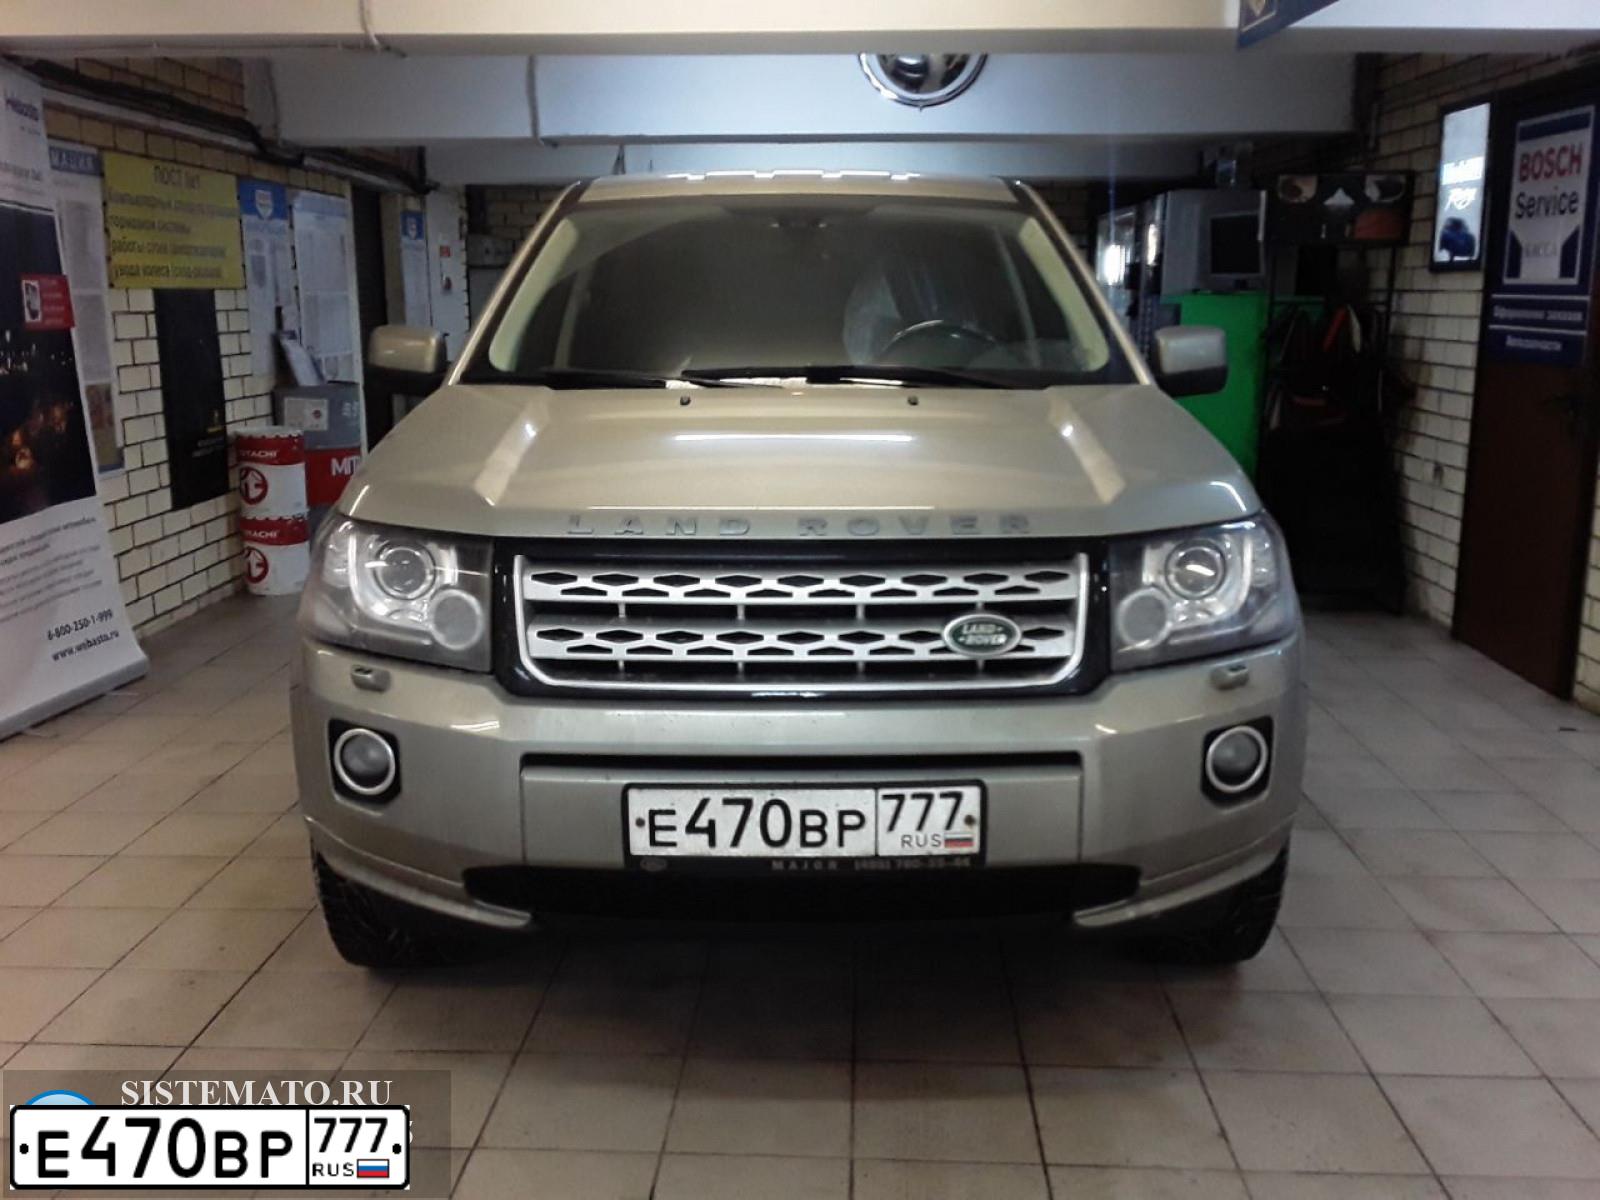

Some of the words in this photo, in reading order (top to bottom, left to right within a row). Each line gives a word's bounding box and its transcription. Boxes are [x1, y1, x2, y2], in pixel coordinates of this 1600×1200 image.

[1519, 144, 1583, 182] BOSCH
[1515, 185, 1579, 219] Service
[243, 530, 278, 539] TACHI
[567, 514, 751, 536] LAND
[799, 514, 1030, 536] ROVER
[881, 791, 964, 832] 777
[901, 834, 941, 849] RUS
